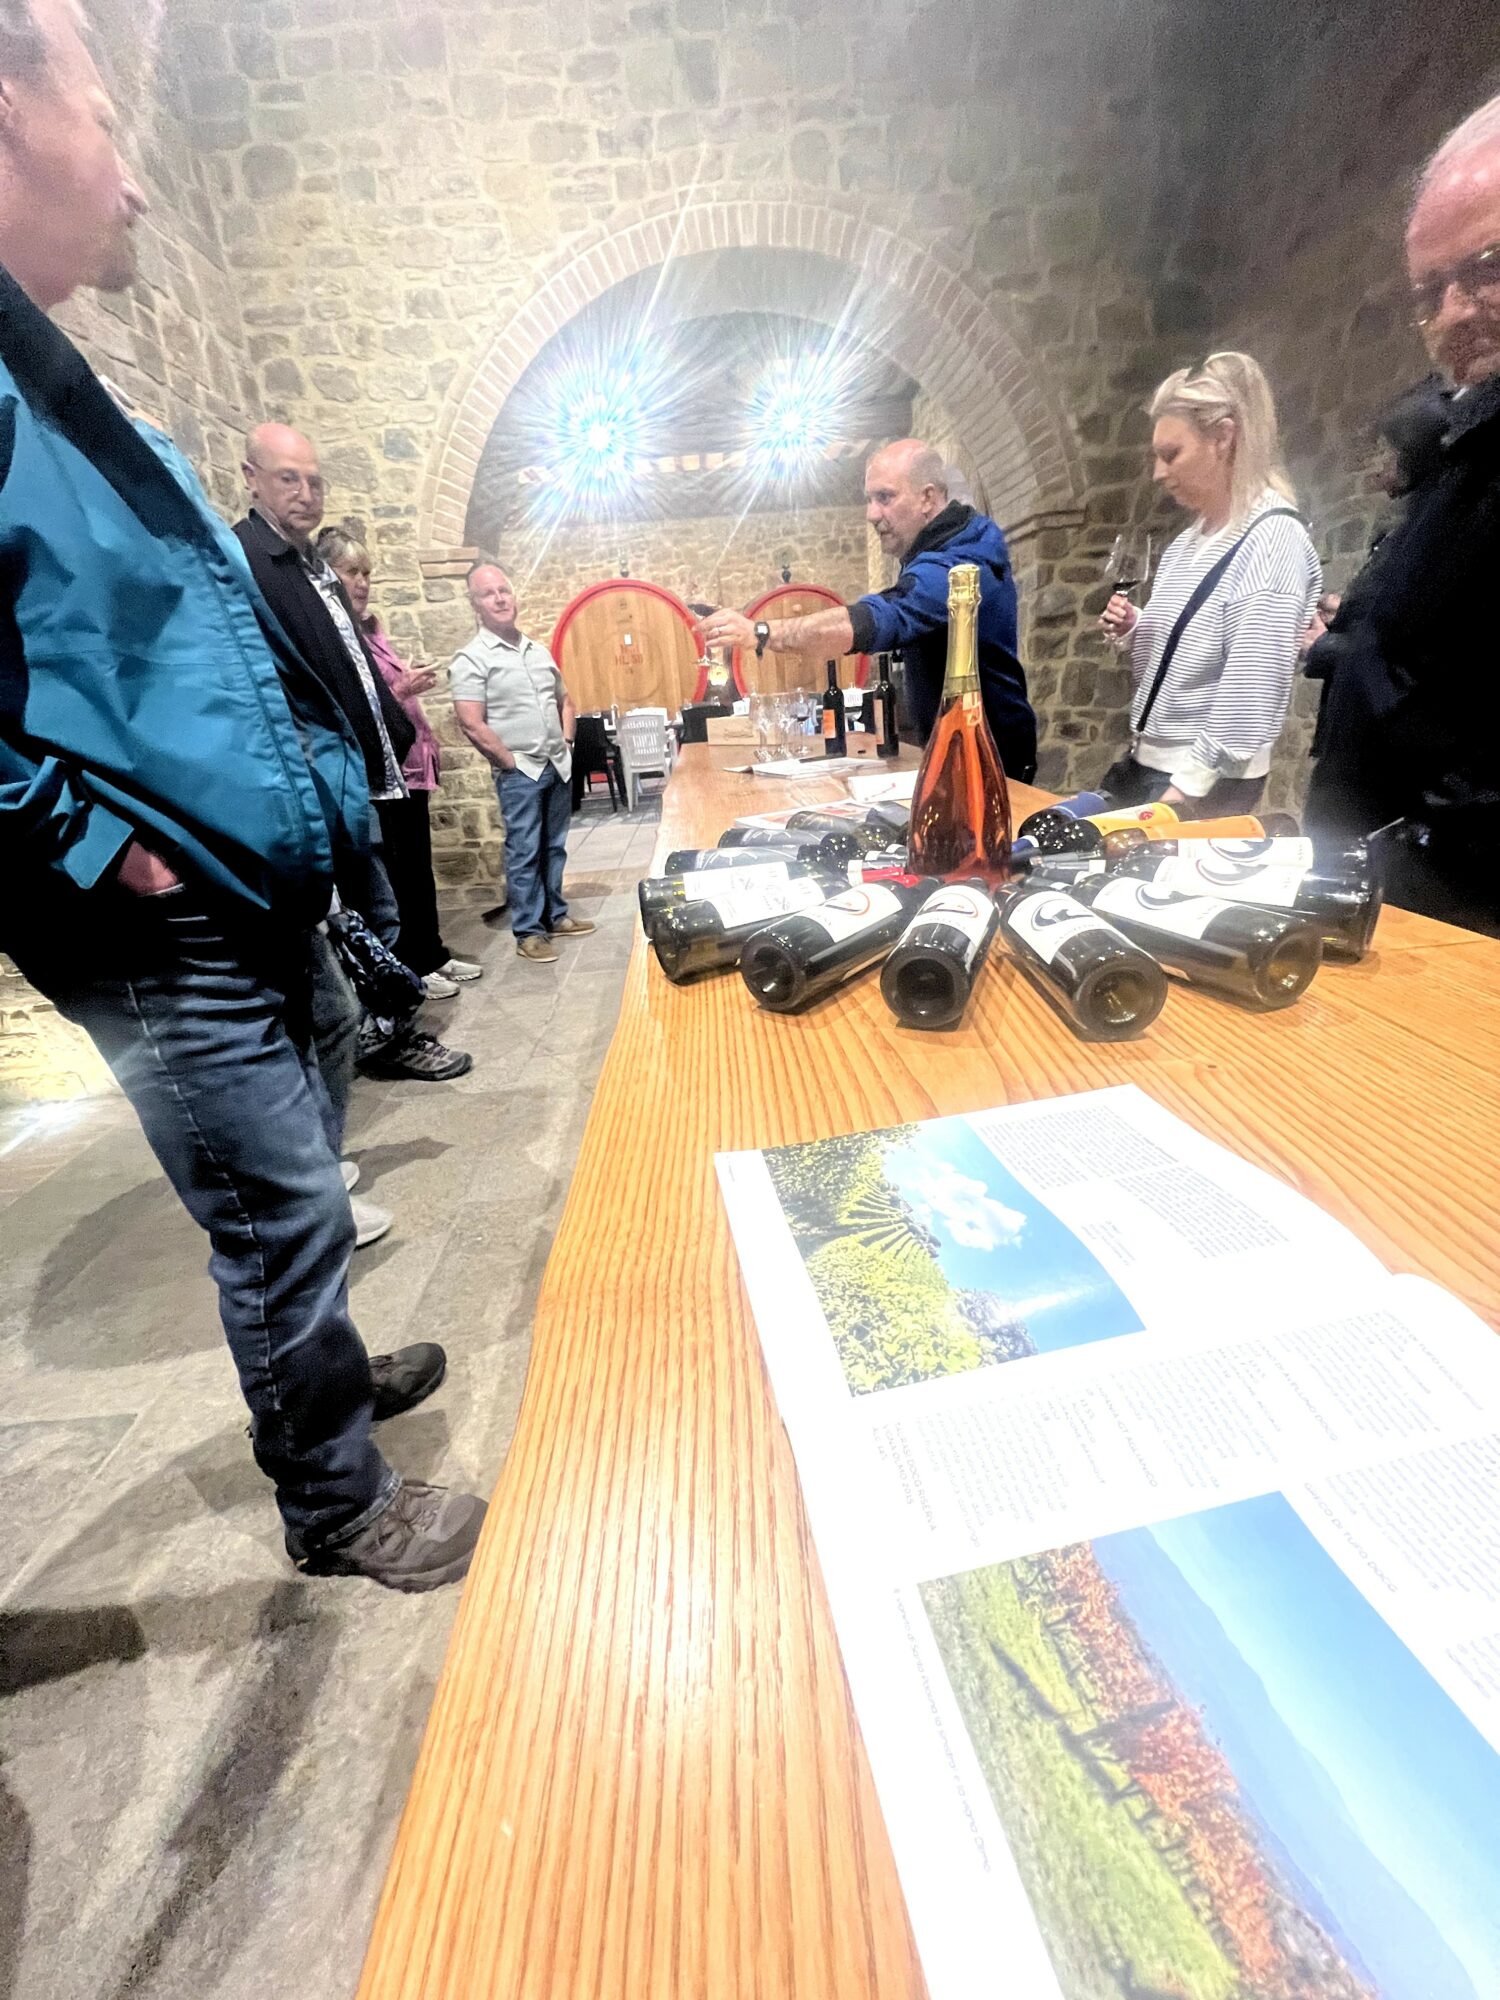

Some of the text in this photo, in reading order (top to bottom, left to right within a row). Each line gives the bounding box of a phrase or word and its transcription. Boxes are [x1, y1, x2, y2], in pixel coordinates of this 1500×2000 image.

[891, 1451, 907, 1480] OLMO
[1125, 1436, 1158, 1487] AGLIANICO
[906, 1458, 922, 1487] DOCG
[917, 1488, 936, 1531] RISERVA
